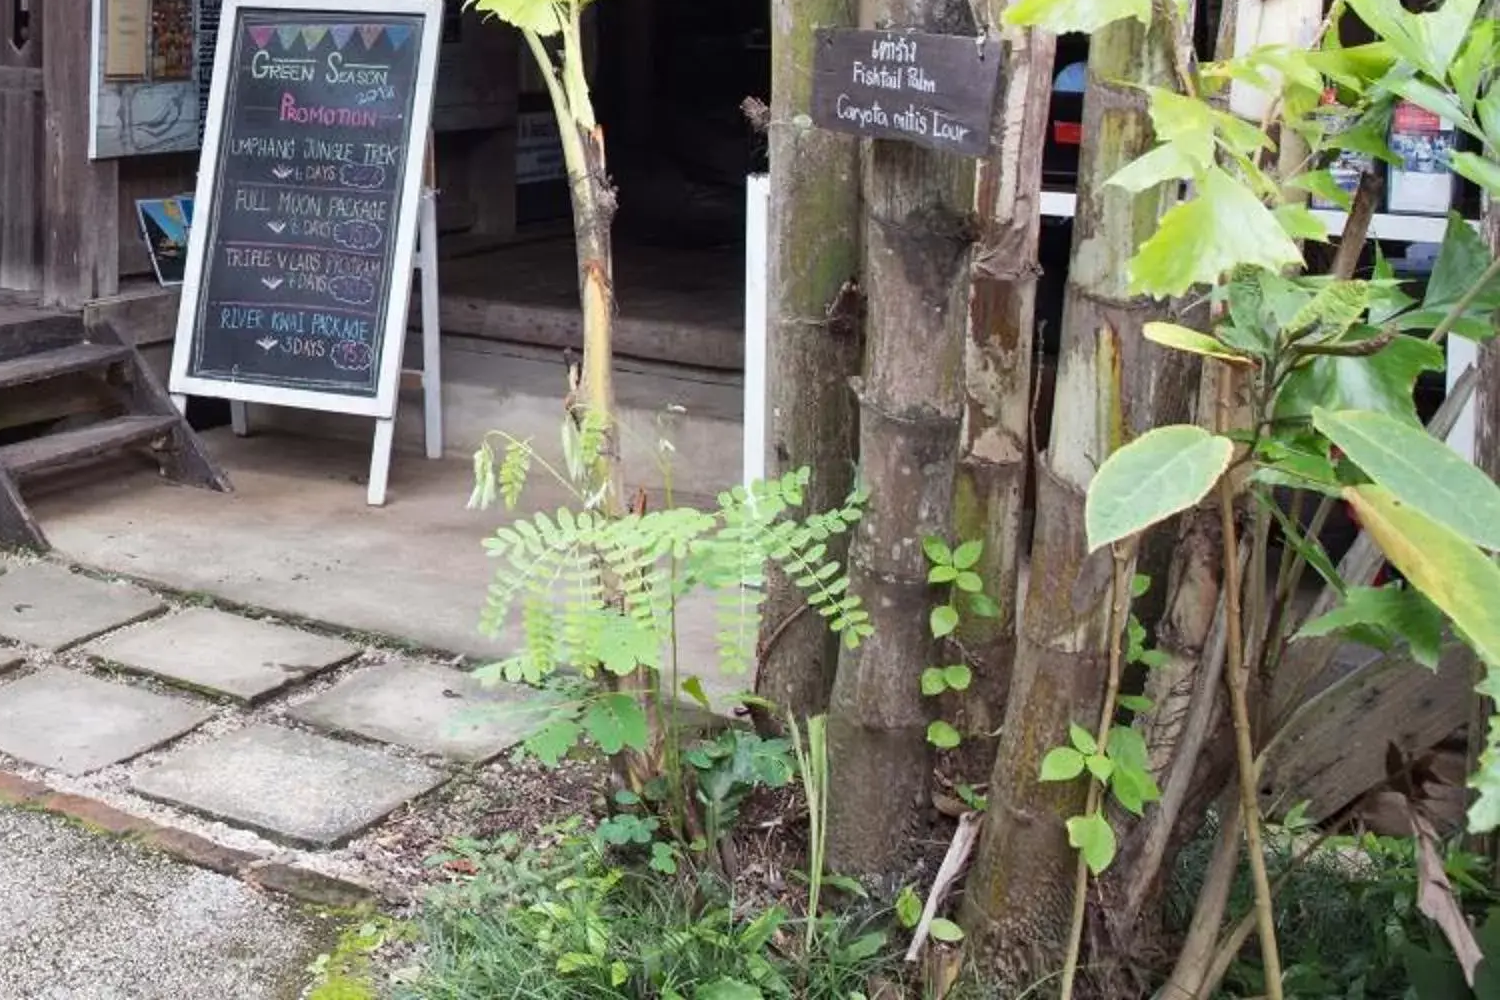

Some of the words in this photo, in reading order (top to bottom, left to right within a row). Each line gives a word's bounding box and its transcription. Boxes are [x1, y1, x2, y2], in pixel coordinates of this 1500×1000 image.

[251, 49, 316, 82] GREEN
[325, 51, 390, 85] SEASON
[853, 61, 903, 89] Fishtail
[908, 67, 936, 93] Palm
[279, 92, 378, 127] PROMOTION
[836, 93, 889, 128] Caryota
[303, 137, 355, 162] JUNGLE
[364, 143, 400, 165] TREK
[305, 165, 336, 181] DAYS
[235, 187, 270, 211] FULL
[278, 190, 321, 216] MOON
[327, 196, 387, 221] PACKAGE
[226, 248, 271, 267] TRIPLE
[220, 308, 263, 330] RIVER
[271, 311, 306, 333] KWAI
[311, 313, 370, 341] PACKAGE
